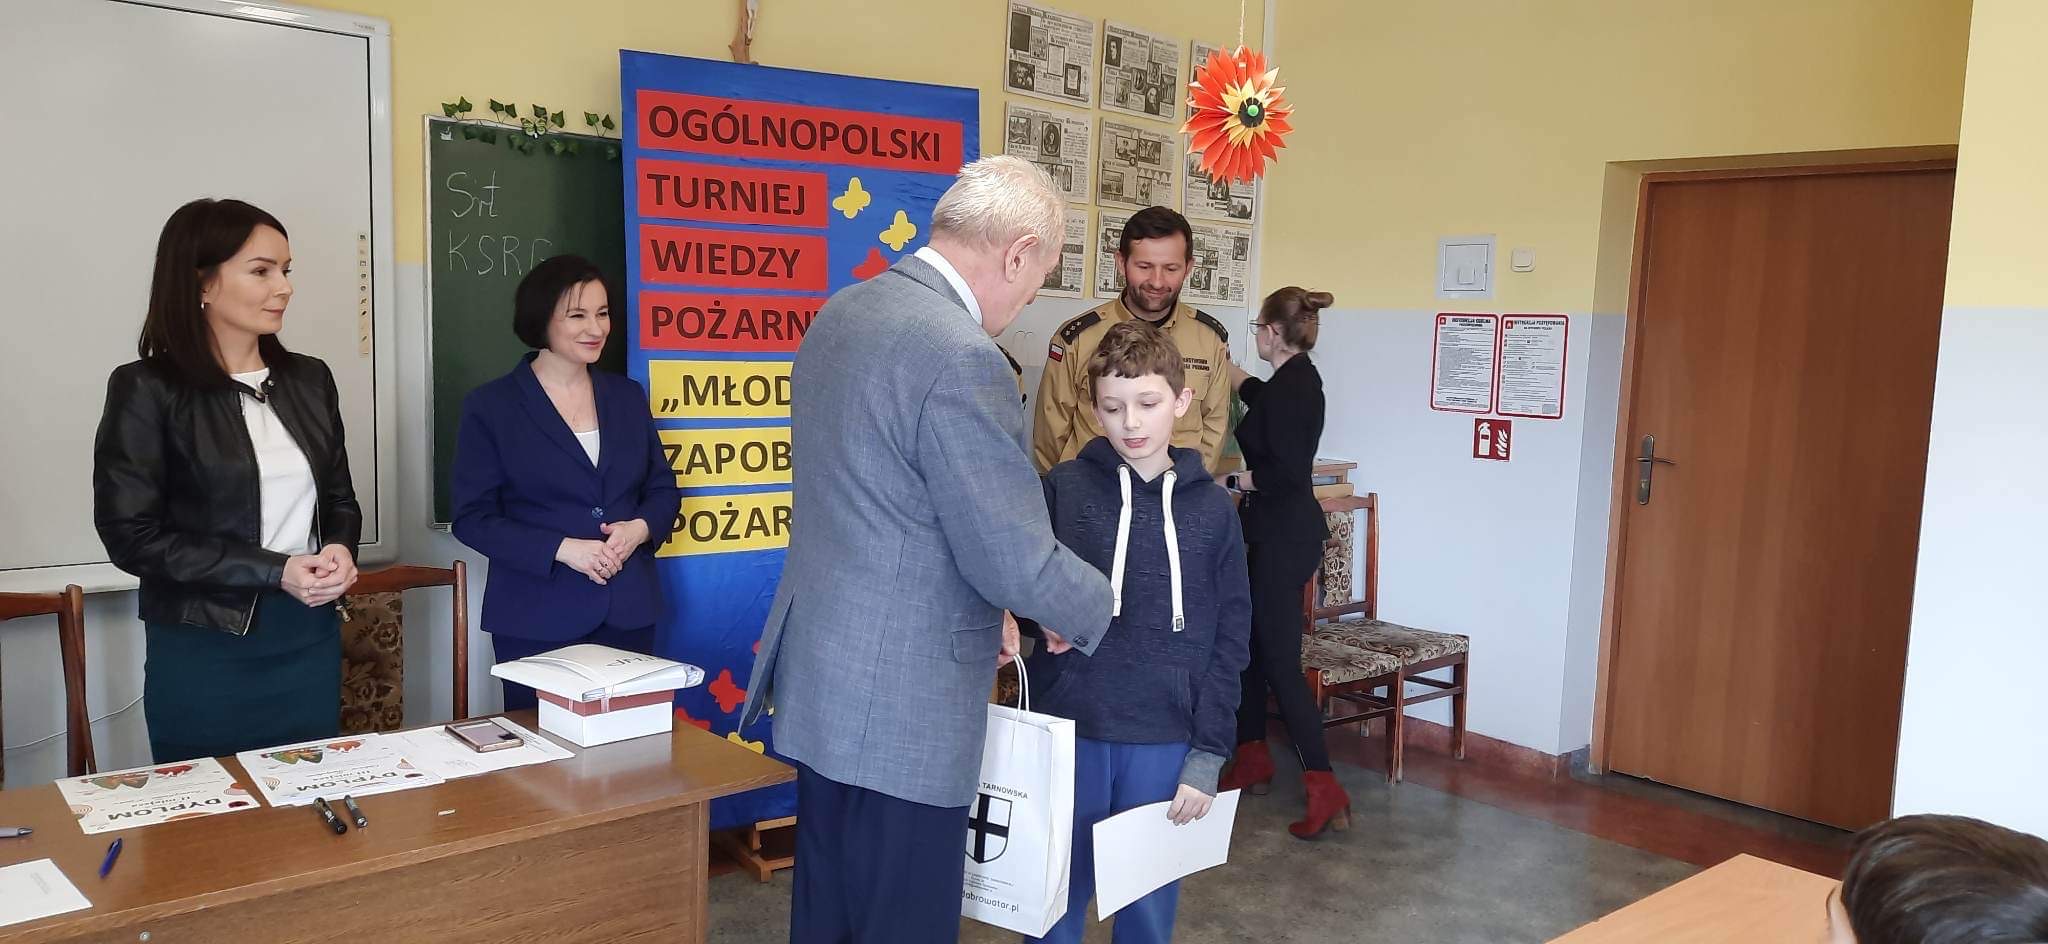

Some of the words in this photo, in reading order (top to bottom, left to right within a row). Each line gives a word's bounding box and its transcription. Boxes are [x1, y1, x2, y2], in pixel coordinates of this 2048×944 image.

[648, 104, 941, 162] OGÓLNOPOLSKI
[646, 173, 806, 216] TURNIEJ
[650, 239, 801, 279] WIEDZY
[651, 300, 819, 340] POŻARN
[297, 771, 398, 791] DYPLOM
[982, 782, 1029, 800] TARNOWSKA
[108, 798, 221, 820] DYPLOM
